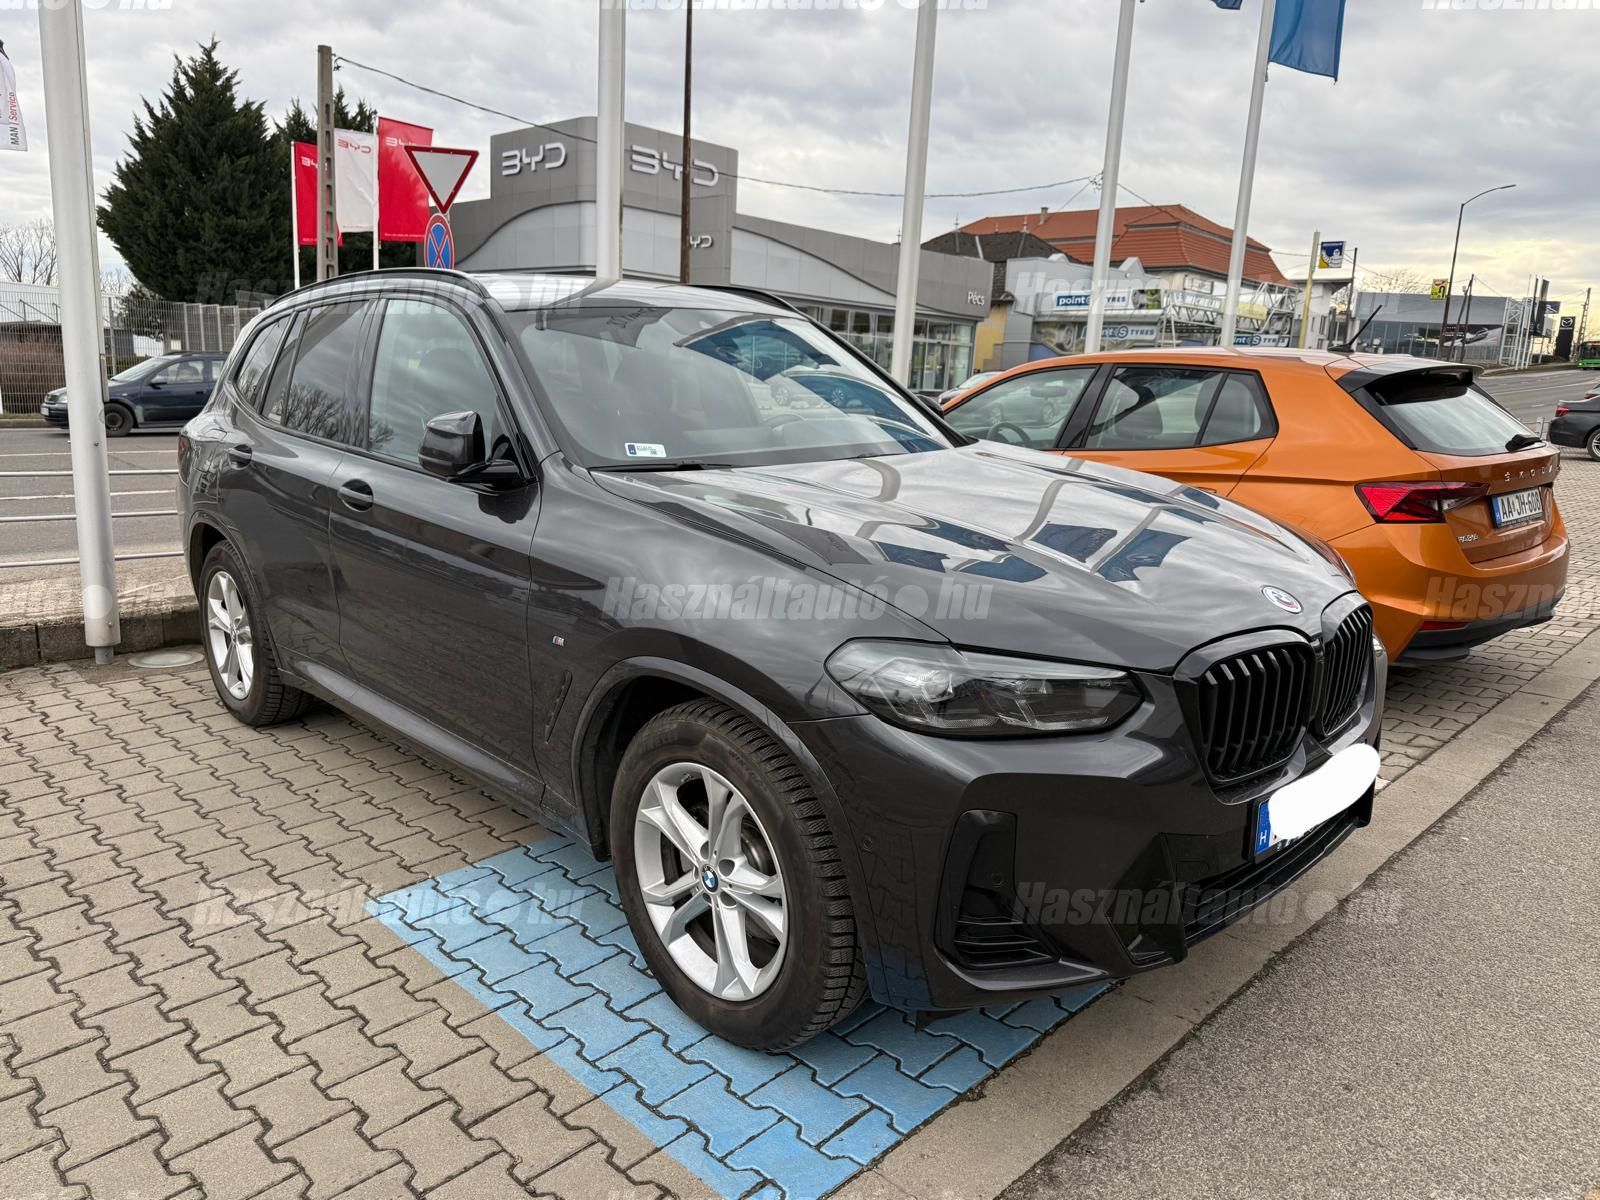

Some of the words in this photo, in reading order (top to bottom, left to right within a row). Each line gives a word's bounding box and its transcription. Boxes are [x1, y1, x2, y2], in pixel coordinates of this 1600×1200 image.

[8, 91, 17, 120] Service
[9, 127, 20, 145] MAN
[502, 142, 566, 176] BYD
[689, 235, 712, 248] YD
[967, 291, 985, 305] Pécs
[1059, 296, 1086, 305] point
